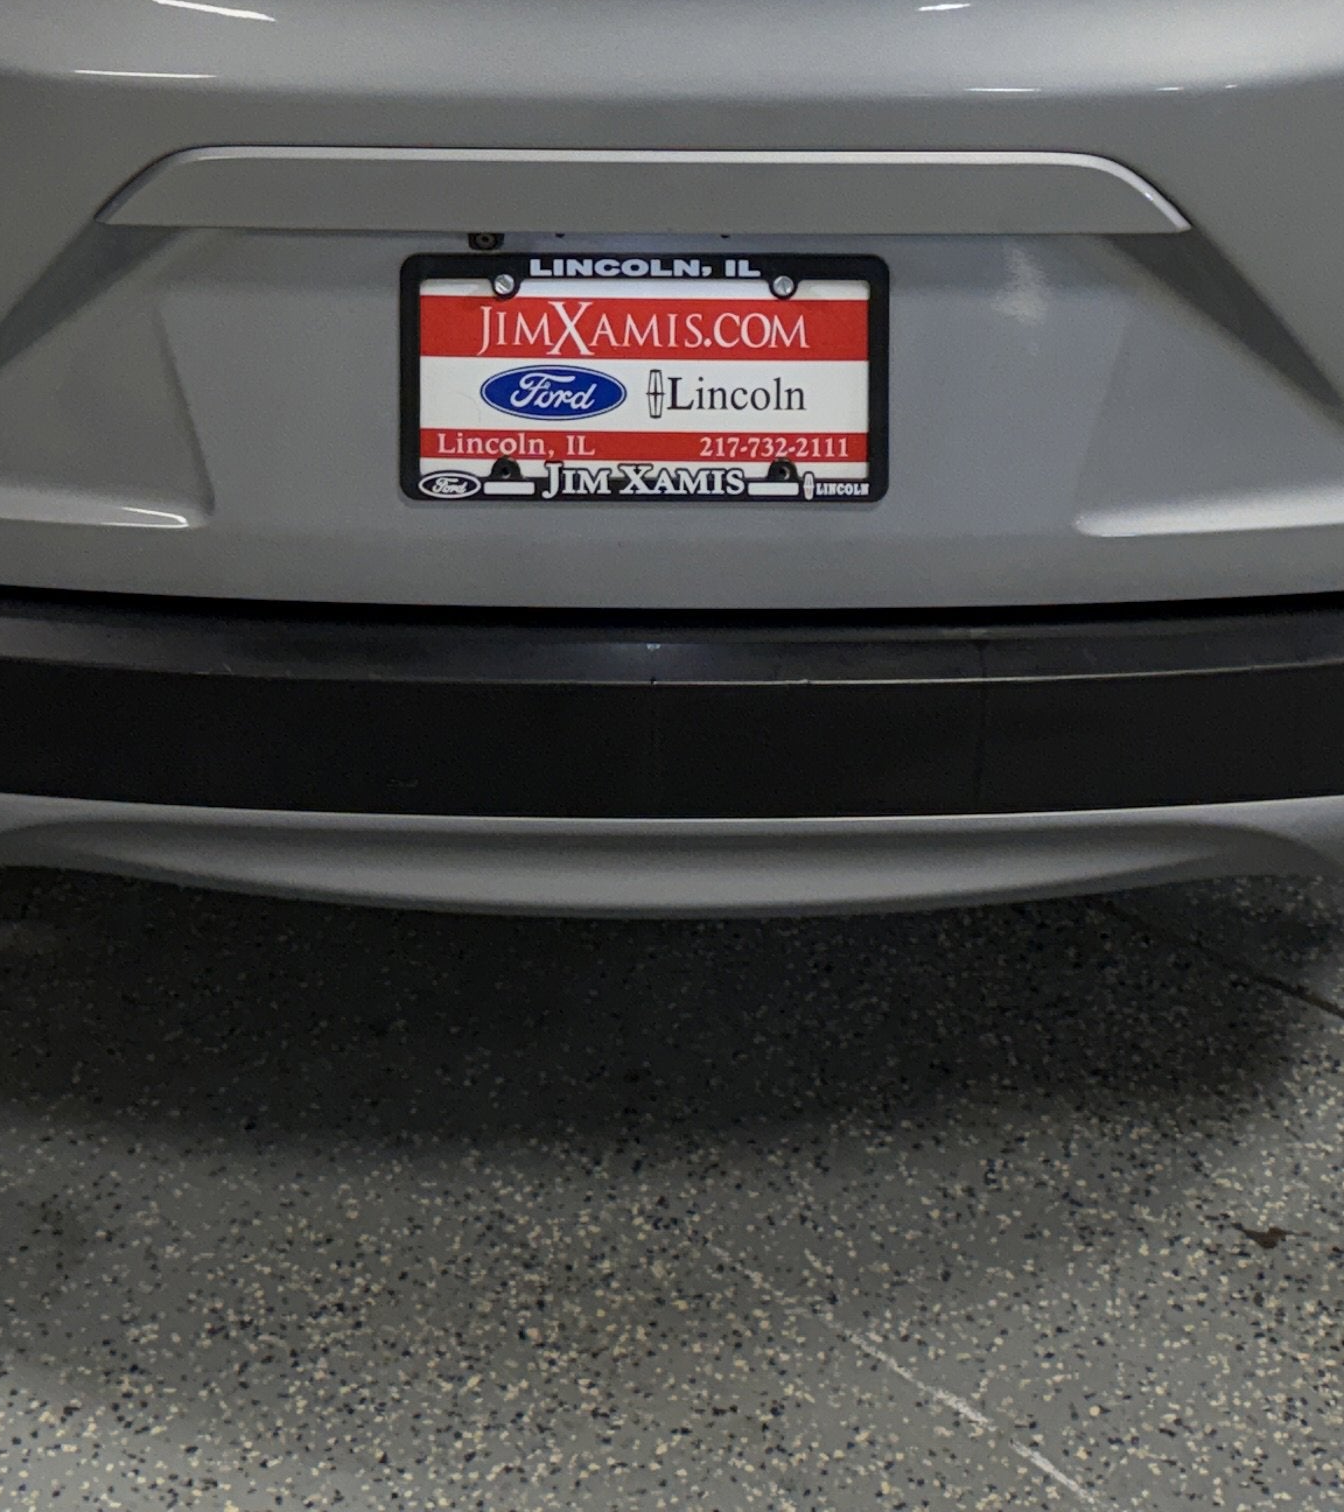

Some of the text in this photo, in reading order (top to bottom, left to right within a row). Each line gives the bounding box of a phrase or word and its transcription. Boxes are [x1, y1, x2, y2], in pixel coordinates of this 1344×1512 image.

[529, 258, 762, 278] LINCOLN, IL
[509, 371, 596, 411] Ford
[667, 376, 807, 412] Lincoln
[437, 432, 596, 459] Lincoln, IL
[699, 436, 848, 458] 217-732-2111
[542, 462, 746, 499] JIM XAMIS
[815, 482, 870, 496] LINCOLN
